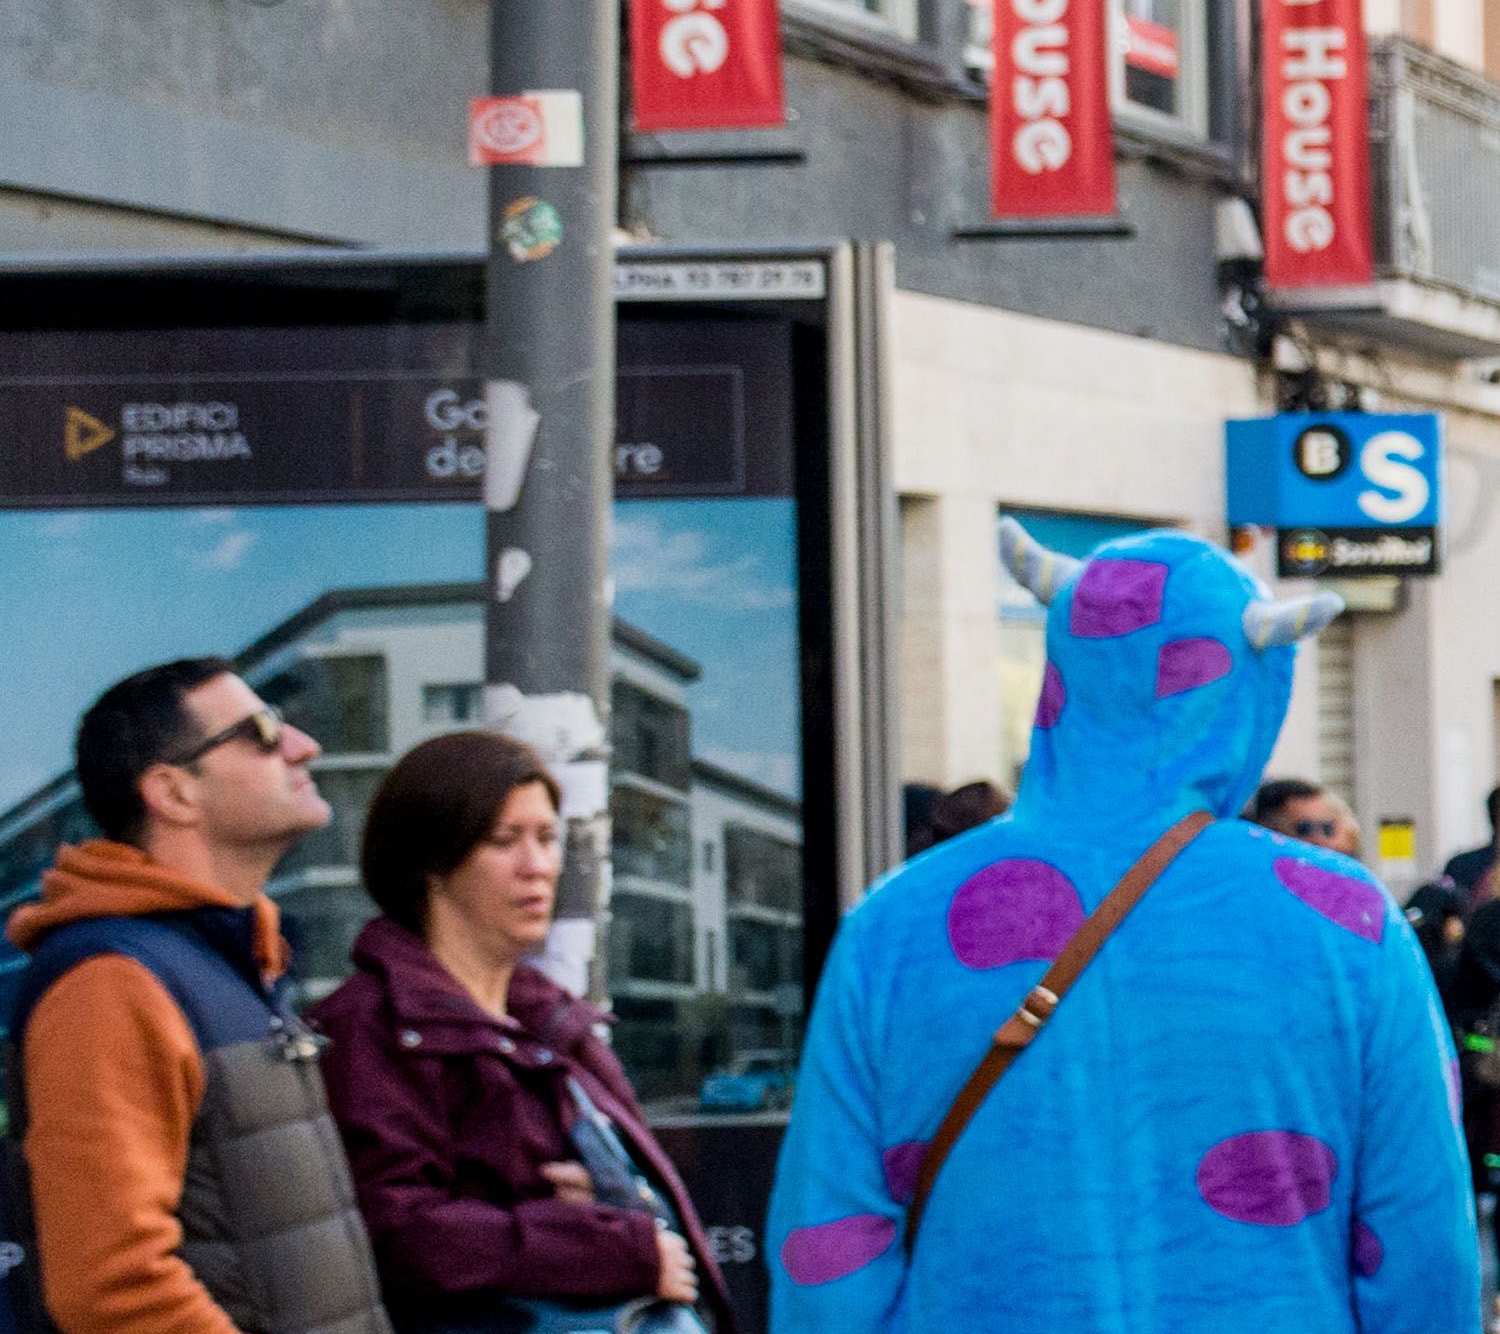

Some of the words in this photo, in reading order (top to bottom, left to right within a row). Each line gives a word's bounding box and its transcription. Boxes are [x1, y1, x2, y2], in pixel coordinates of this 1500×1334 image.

[1279, 26, 1349, 253] House
[121, 432, 253, 461] PRISMA
[1357, 430, 1430, 525] S
